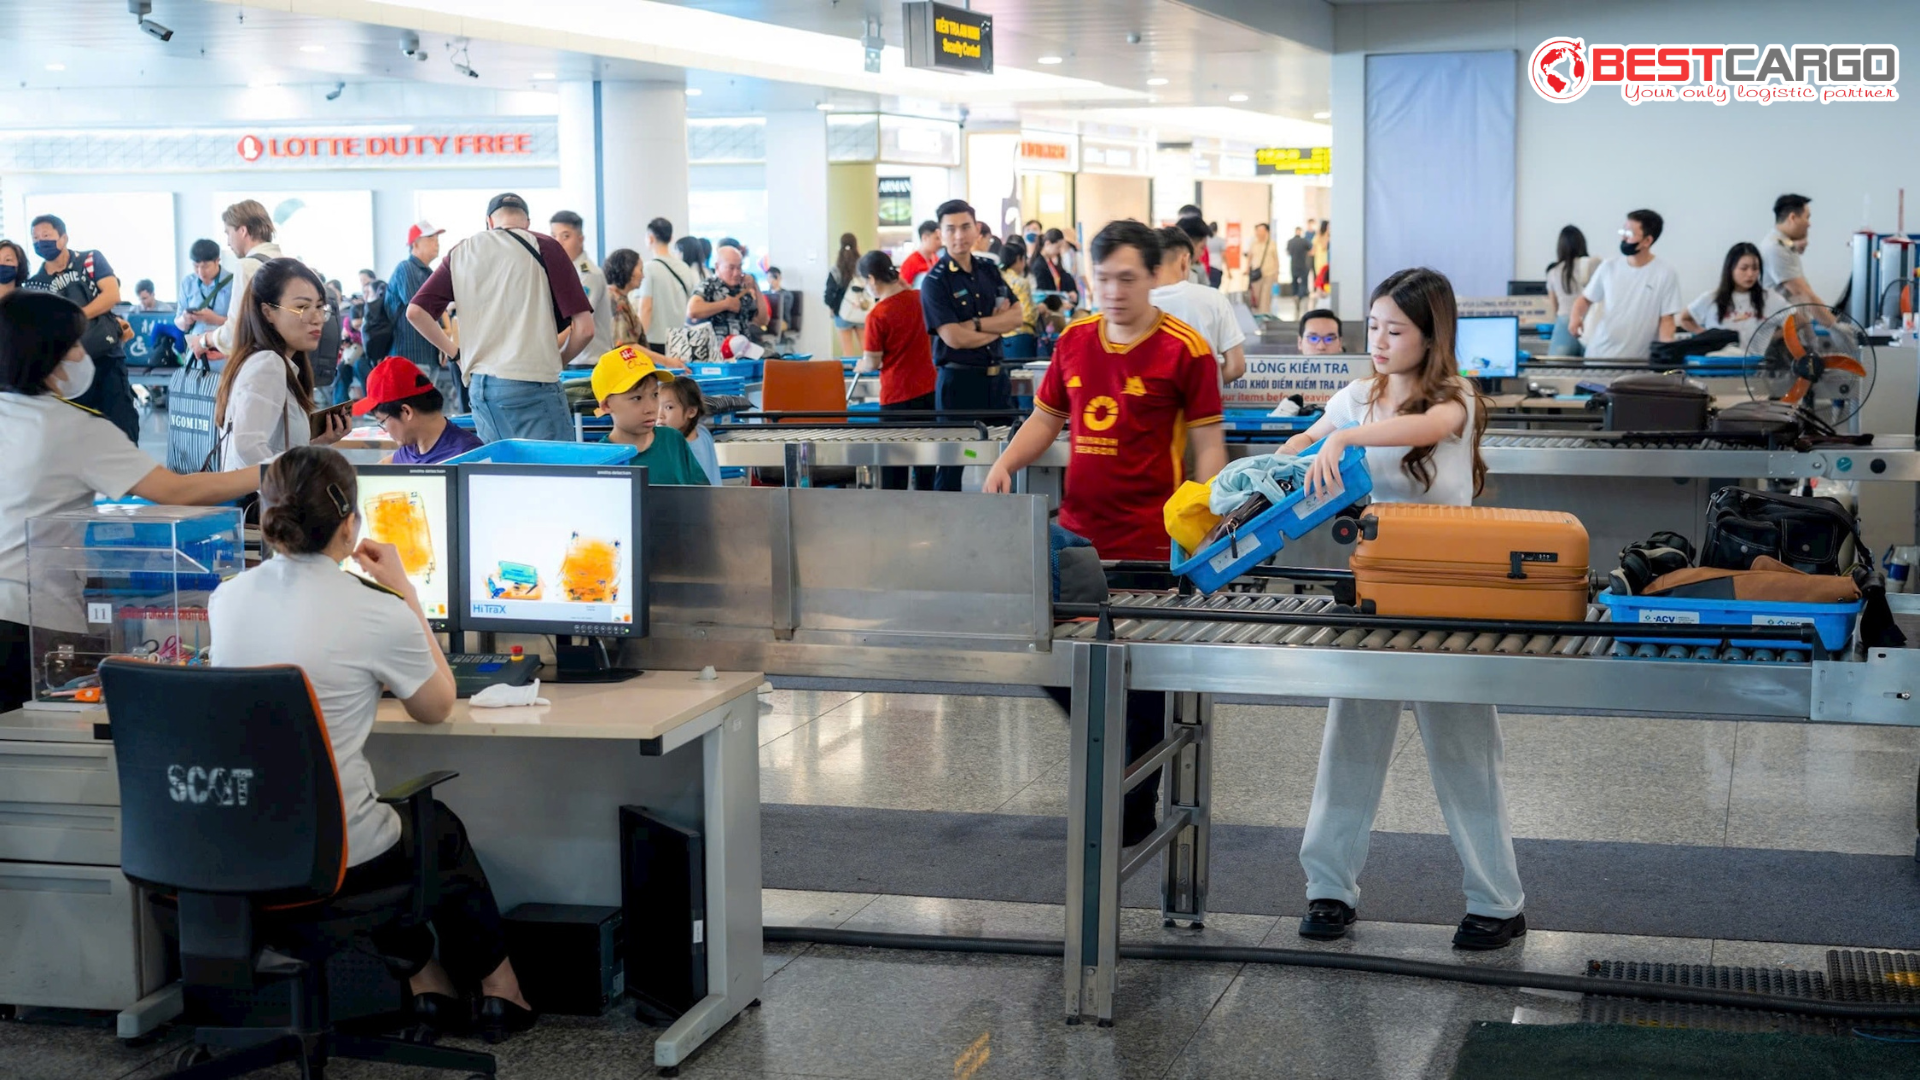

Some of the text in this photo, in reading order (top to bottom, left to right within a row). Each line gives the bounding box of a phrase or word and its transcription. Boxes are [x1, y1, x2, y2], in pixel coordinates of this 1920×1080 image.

[268, 133, 532, 158] LOTTE DUTY FREE
[1251, 360, 1286, 374] LÒNG
[1289, 358, 1321, 374] KIỂM
[1324, 362, 1350, 374] TRA
[1319, 380, 1335, 389] TRA
[1238, 392, 1264, 401] items
[93, 608, 107, 620] 11
[1655, 615, 1676, 623] ACV
